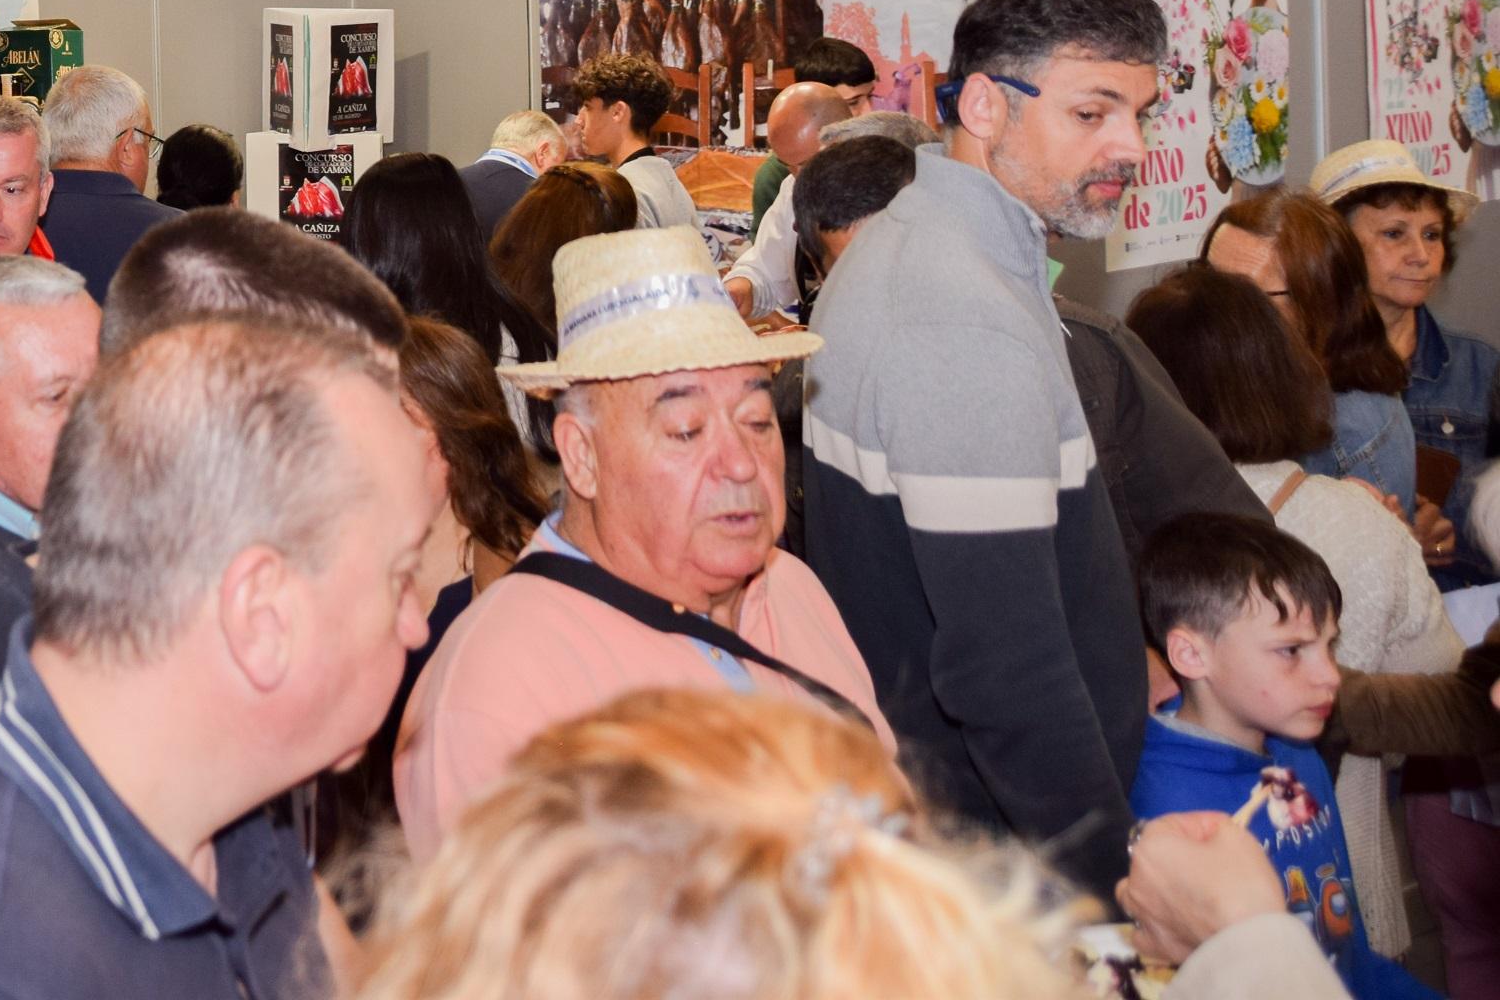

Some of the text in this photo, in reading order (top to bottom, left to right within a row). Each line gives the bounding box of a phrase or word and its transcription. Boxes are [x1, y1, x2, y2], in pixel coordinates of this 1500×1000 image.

[1, 47, 41, 70] ABELÁN
[337, 103, 367, 114] A CAÑIZA
[1131, 140, 1184, 187] UÑO
[1124, 183, 1207, 230] de 2025
[302, 222, 340, 232] CAÑIZA
